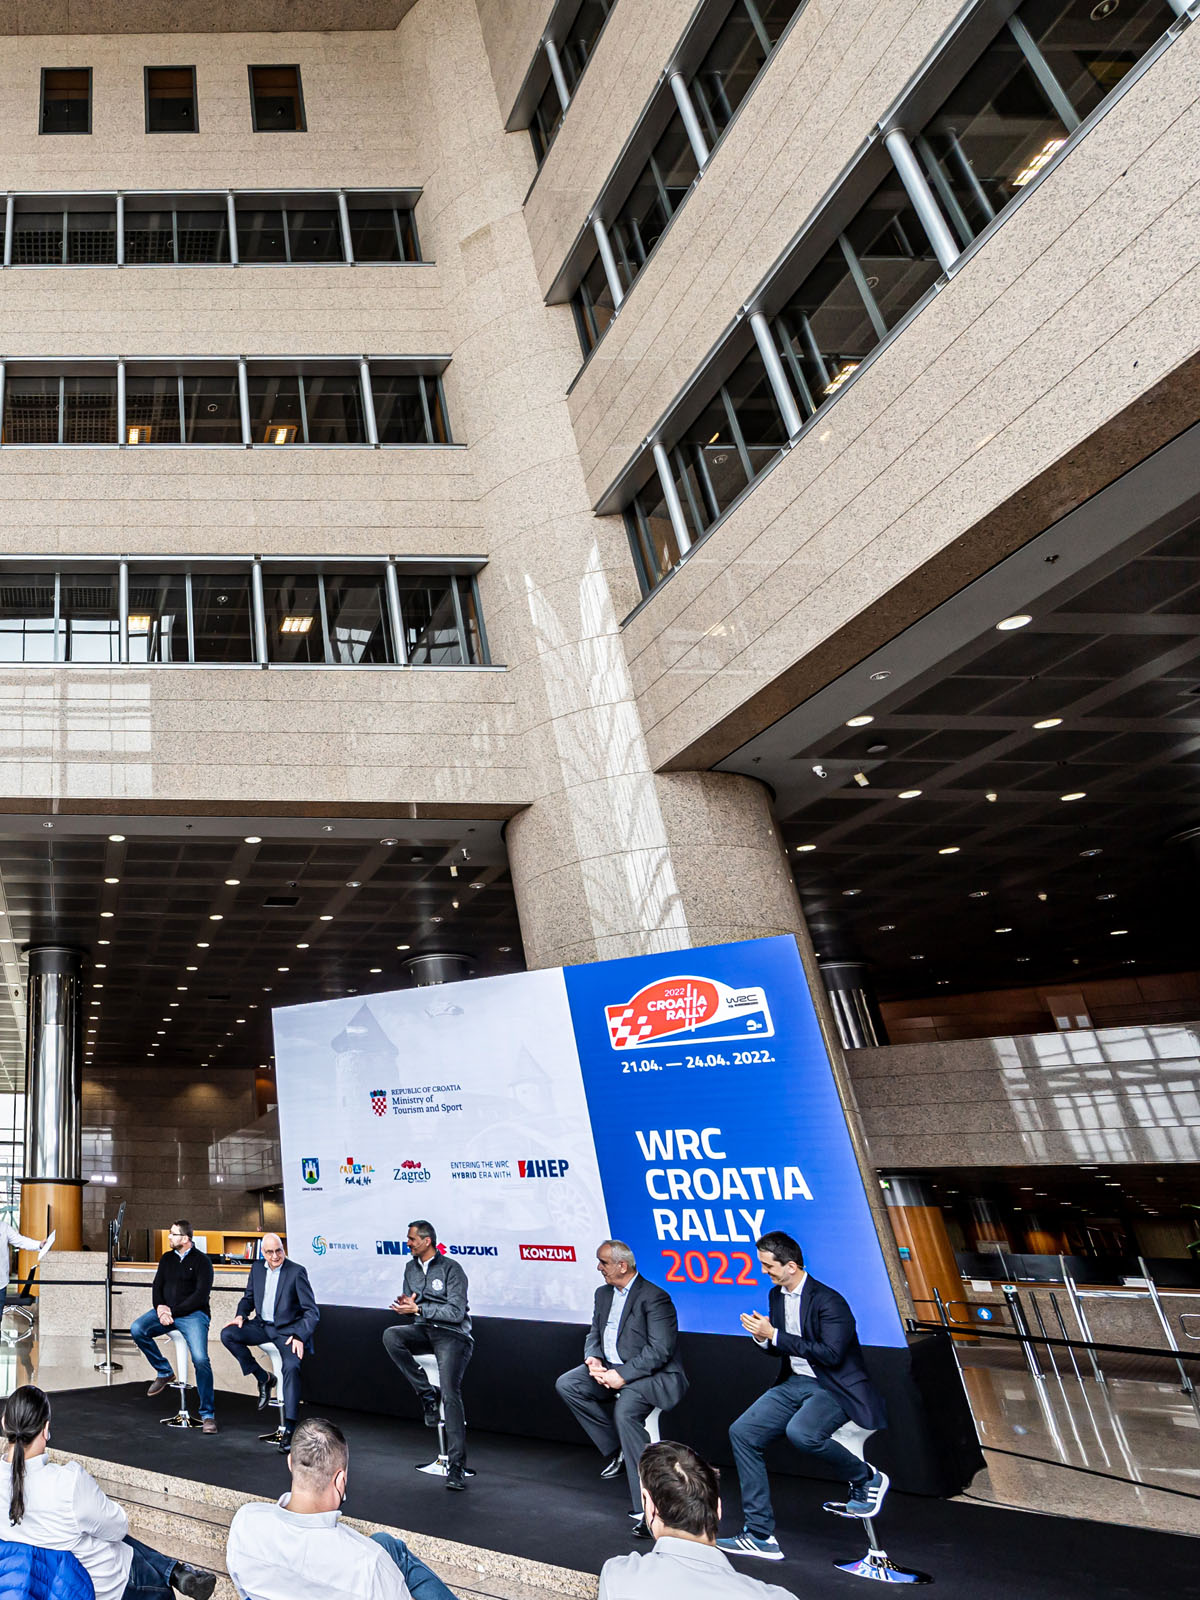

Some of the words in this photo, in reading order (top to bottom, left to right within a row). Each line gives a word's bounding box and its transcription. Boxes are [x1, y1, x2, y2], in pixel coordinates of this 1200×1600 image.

[664, 988, 685, 997] 2022
[726, 994, 758, 1004] WRC
[647, 995, 708, 1012] CROATIA
[666, 1006, 708, 1021] RALLY
[621, 1059, 663, 1073] 21.04.
[685, 1054, 730, 1068] 24.04.
[732, 1050, 776, 1065] 2022.
[391, 1087, 422, 1096] REPUBLIC
[432, 1084, 462, 1092] CROATIA
[392, 1096, 424, 1105] Ministry
[425, 1094, 434, 1103] of
[393, 1105, 425, 1115] Tourism
[425, 1104, 440, 1113] and
[441, 1103, 463, 1114] Sport
[635, 1127, 727, 1161] WRC
[450, 1161, 481, 1169] ENTERING
[494, 1160, 509, 1168] WRC
[535, 1160, 569, 1177] HEP
[393, 1167, 432, 1184] Zagreb
[451, 1171, 478, 1179] HYBRID
[478, 1171, 493, 1179] ERA
[645, 1166, 814, 1201] CROATIA
[652, 1208, 766, 1243] RALLY
[449, 1245, 498, 1256] SUZUKI
[523, 1247, 573, 1260] KONZUM
[661, 1250, 758, 1286] 2022
